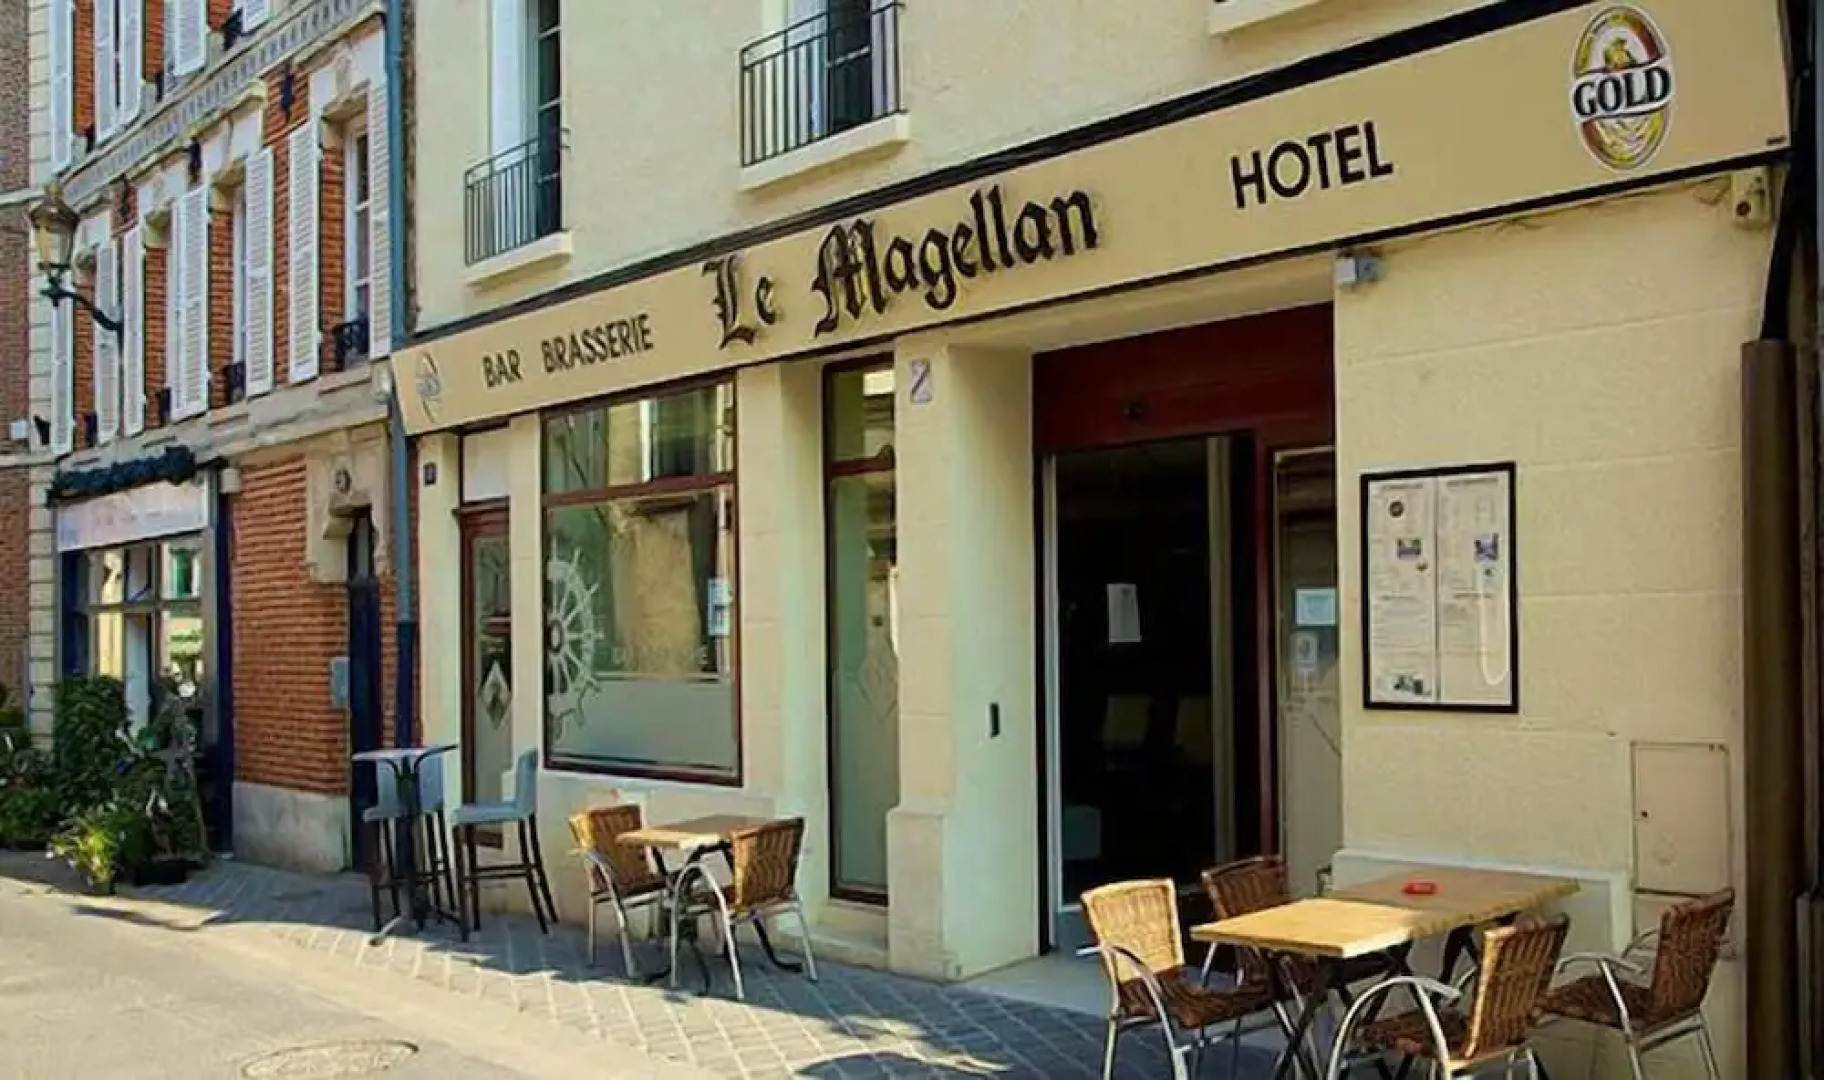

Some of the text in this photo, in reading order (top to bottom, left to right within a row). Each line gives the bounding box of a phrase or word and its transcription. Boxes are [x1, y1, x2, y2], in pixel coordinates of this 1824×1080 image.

[1573, 66, 1671, 117] GOLD
[1231, 121, 1394, 209] HOTEL
[702, 184, 1099, 350] Le Magellan
[482, 348, 524, 388] BAR
[540, 313, 654, 373] BRASSERIE
